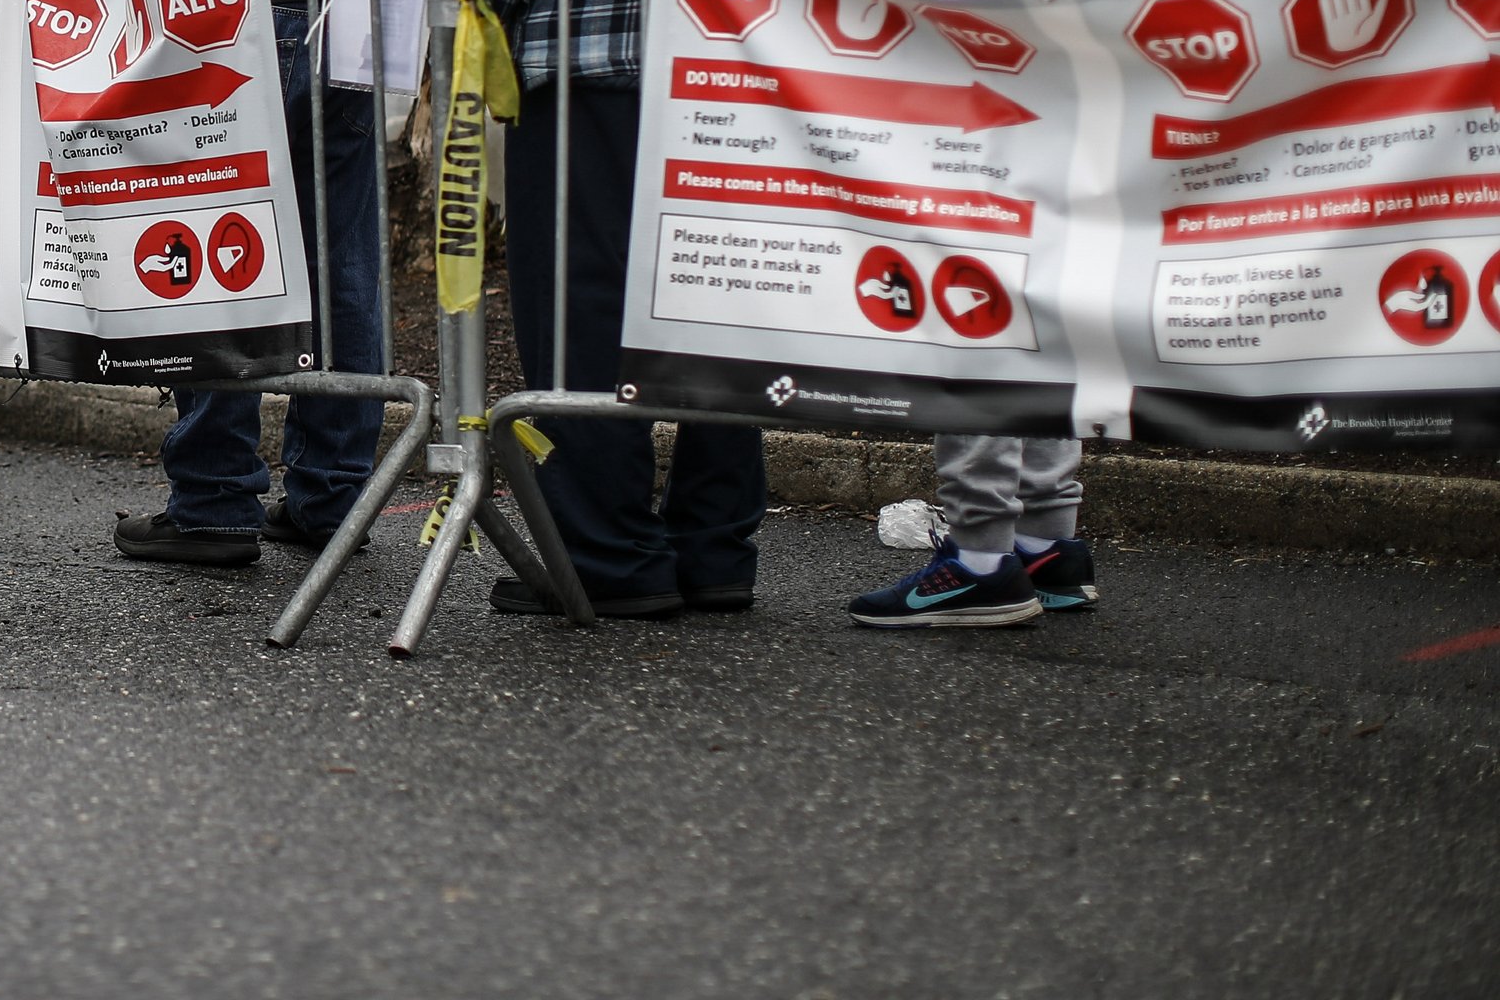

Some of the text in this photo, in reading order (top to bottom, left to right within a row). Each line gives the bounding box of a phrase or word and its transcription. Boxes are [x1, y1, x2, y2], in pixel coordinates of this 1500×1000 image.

[27, 0, 92, 40] STOP
[1148, 30, 1238, 60] STOP
[686, 70, 708, 86] DO
[710, 72, 740, 88] YOU
[191, 109, 237, 128] Debilidad
[694, 111, 736, 126] Fever?
[60, 120, 168, 142] Dolor de garganta?
[195, 130, 228, 149] grave?
[806, 123, 892, 145] Sore throat?
[1166, 129, 1220, 147] TIENE?
[1293, 124, 1436, 157] Dolor de garganta?
[63, 143, 123, 160] Cansancio?
[693, 132, 777, 153] New cough?
[934, 137, 983, 154] Severe
[810, 144, 860, 164] Fatigue?
[438, 92, 482, 257] CAUTION
[932, 160, 1010, 182] weakness?
[1180, 157, 1239, 178] Fiebre?
[1292, 154, 1374, 179] Cansancio?
[56, 184, 72, 196] tre
[74, 186, 80, 194] a
[88, 178, 126, 194] tienda
[130, 177, 159, 194] para
[162, 174, 185, 186] una
[187, 166, 238, 183] evaluación
[1184, 168, 1270, 192] Tos nueva?
[678, 171, 1020, 224] Please come in the tent for screening & evaluation
[1178, 186, 1500, 232] Por favor entre a la tienda para una evalu
[46, 222, 62, 235] Por
[68, 233, 88, 244] vese
[674, 229, 842, 256] Please clean your hands
[44, 242, 72, 254] mano
[73, 252, 94, 264] ngase
[672, 250, 820, 276] and put on a mask as
[43, 258, 76, 274] másca
[1172, 273, 1198, 286] Por
[1246, 264, 1294, 282] lávese
[1299, 264, 1322, 279] las
[40, 276, 70, 290] como
[670, 272, 812, 295] soon as you come in
[1168, 285, 1343, 308] manos y póngase una
[1168, 308, 1326, 328] máscara tan pronto
[1169, 334, 1261, 348] como entre
[112, 356, 193, 368] The Brooklyn Hospital Center
[798, 390, 911, 408] The Brooklyn Hospital Center
[1332, 416, 1454, 429] The Brooklyn Hospital Center
